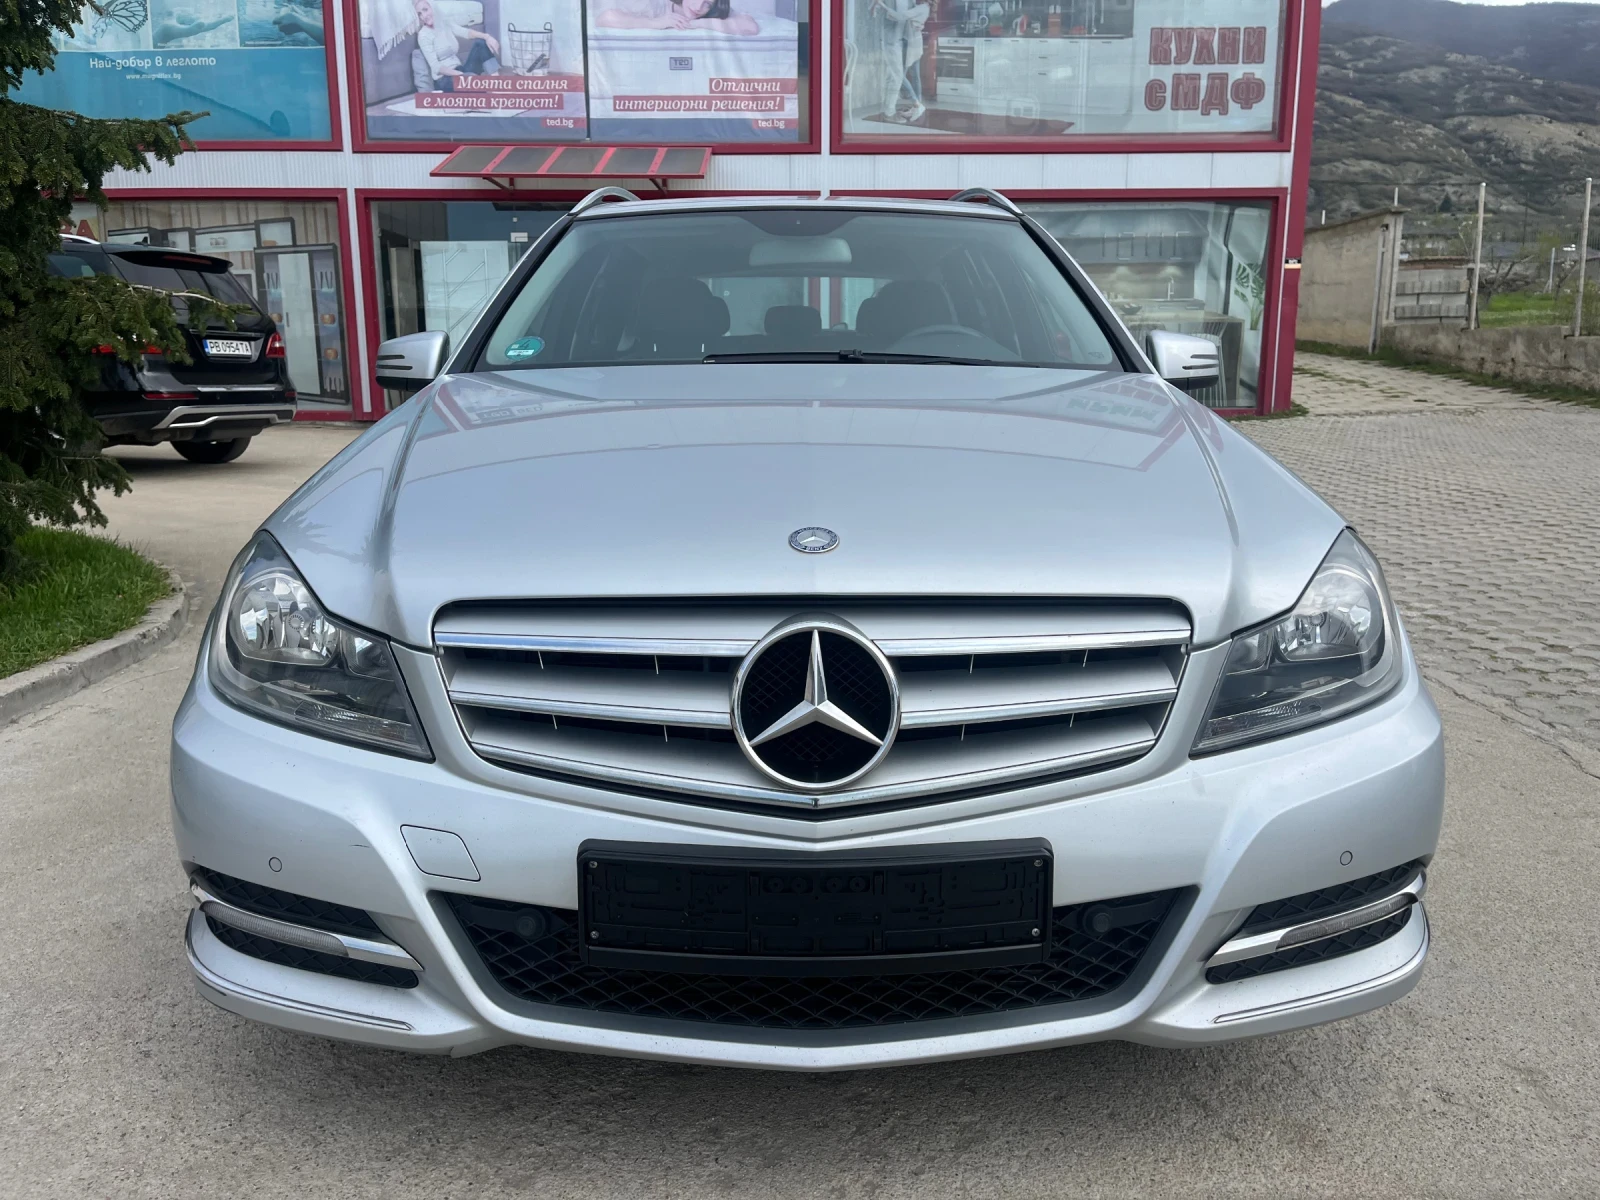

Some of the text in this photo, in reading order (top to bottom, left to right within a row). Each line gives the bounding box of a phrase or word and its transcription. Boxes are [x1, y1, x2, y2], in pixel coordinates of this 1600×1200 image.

[1149, 27, 1266, 65] КУХНИ
[89, 56, 217, 70] Най-добър в леглото
[457, 75, 568, 90] Моята спалня
[711, 78, 781, 92] Отлични
[1170, 72, 1266, 116] МДФ
[423, 95, 559, 109] е моята крепост!
[615, 97, 780, 112] интериорни решения!
[546, 118, 574, 128] ted.bg
[757, 119, 785, 129] ted.bg
